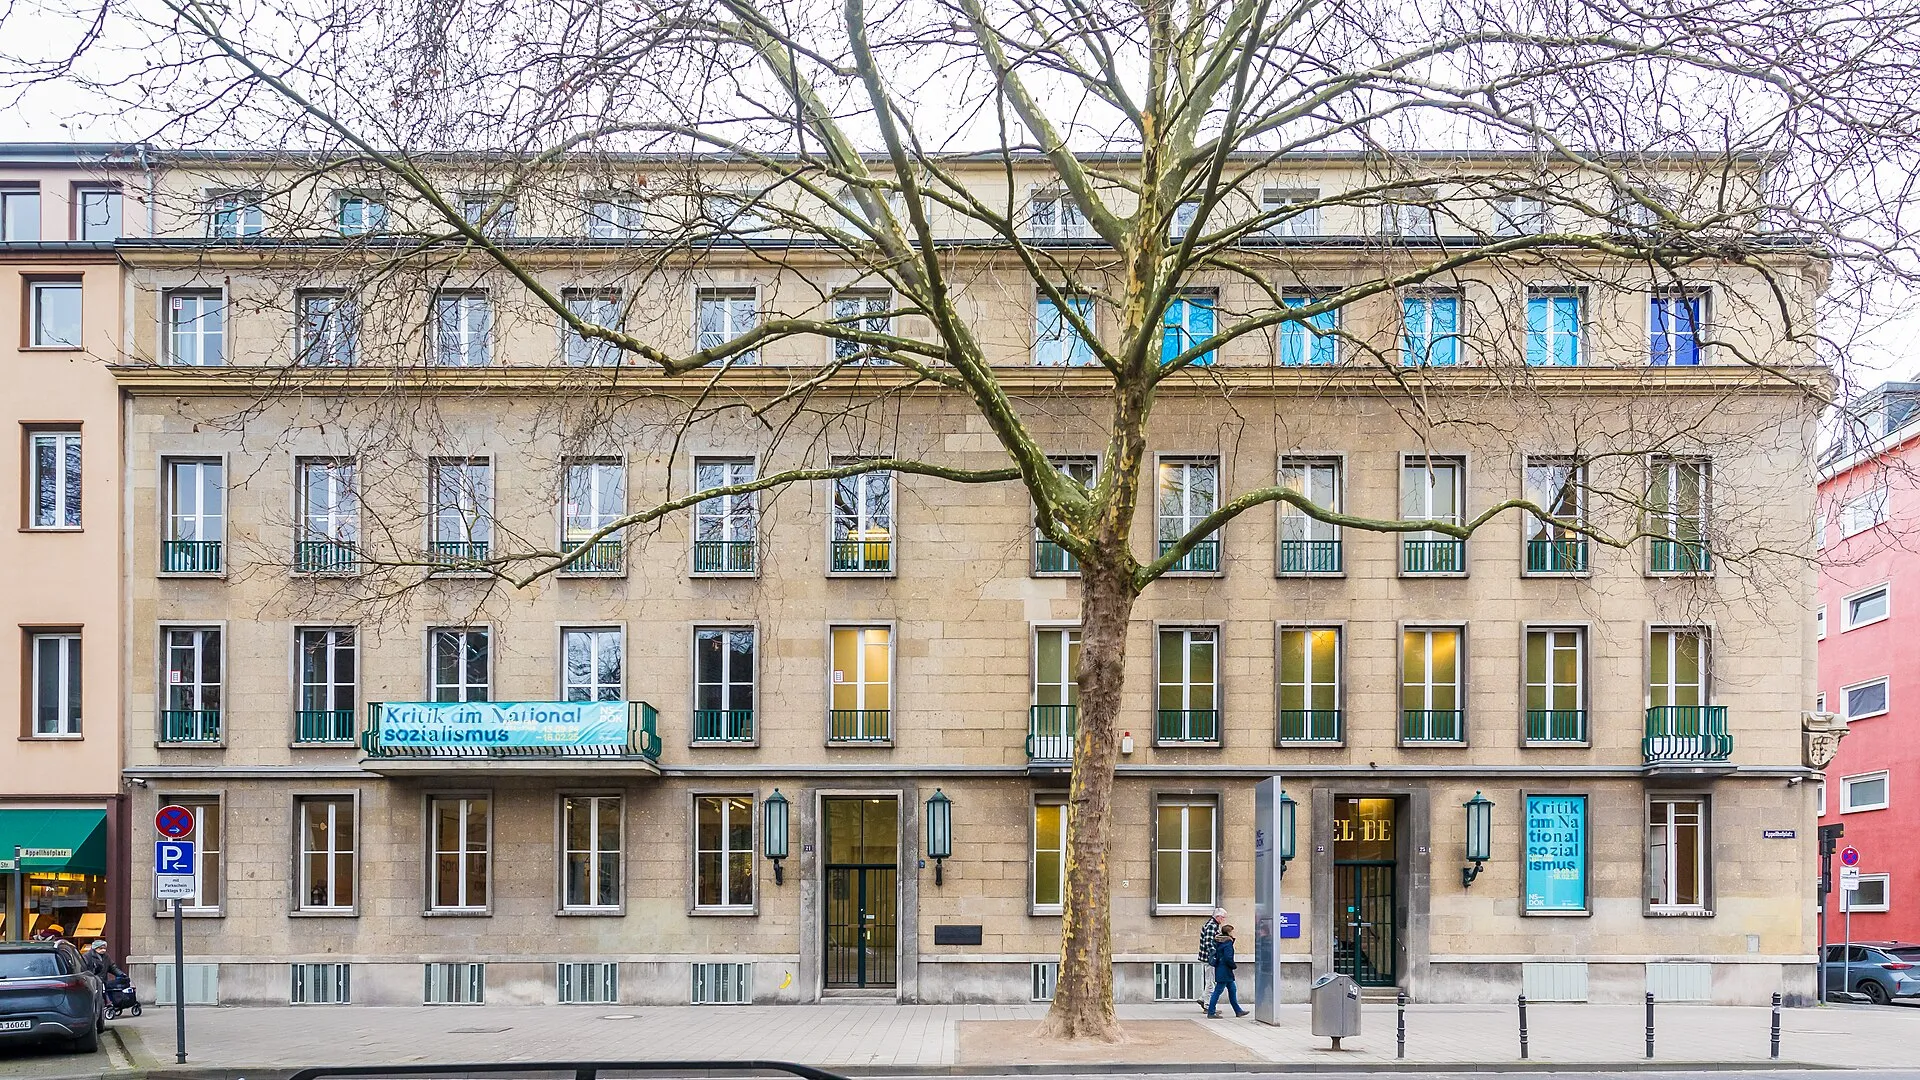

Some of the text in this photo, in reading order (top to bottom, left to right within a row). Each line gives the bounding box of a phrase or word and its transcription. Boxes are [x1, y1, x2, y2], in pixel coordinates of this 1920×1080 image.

[385, 707, 444, 723] Kritik
[490, 707, 581, 723] National
[384, 720, 509, 742] sozialismus
[1529, 801, 1579, 814] Kritik
[1558, 815, 1579, 828] Na
[1362, 819, 1391, 841] DE
[1528, 829, 1579, 843] tional
[25, 849, 67, 857] Appellhofplatz
[1528, 844, 1579, 857] sozial
[162, 845, 183, 870] P
[1529, 860, 1576, 871] ismus
